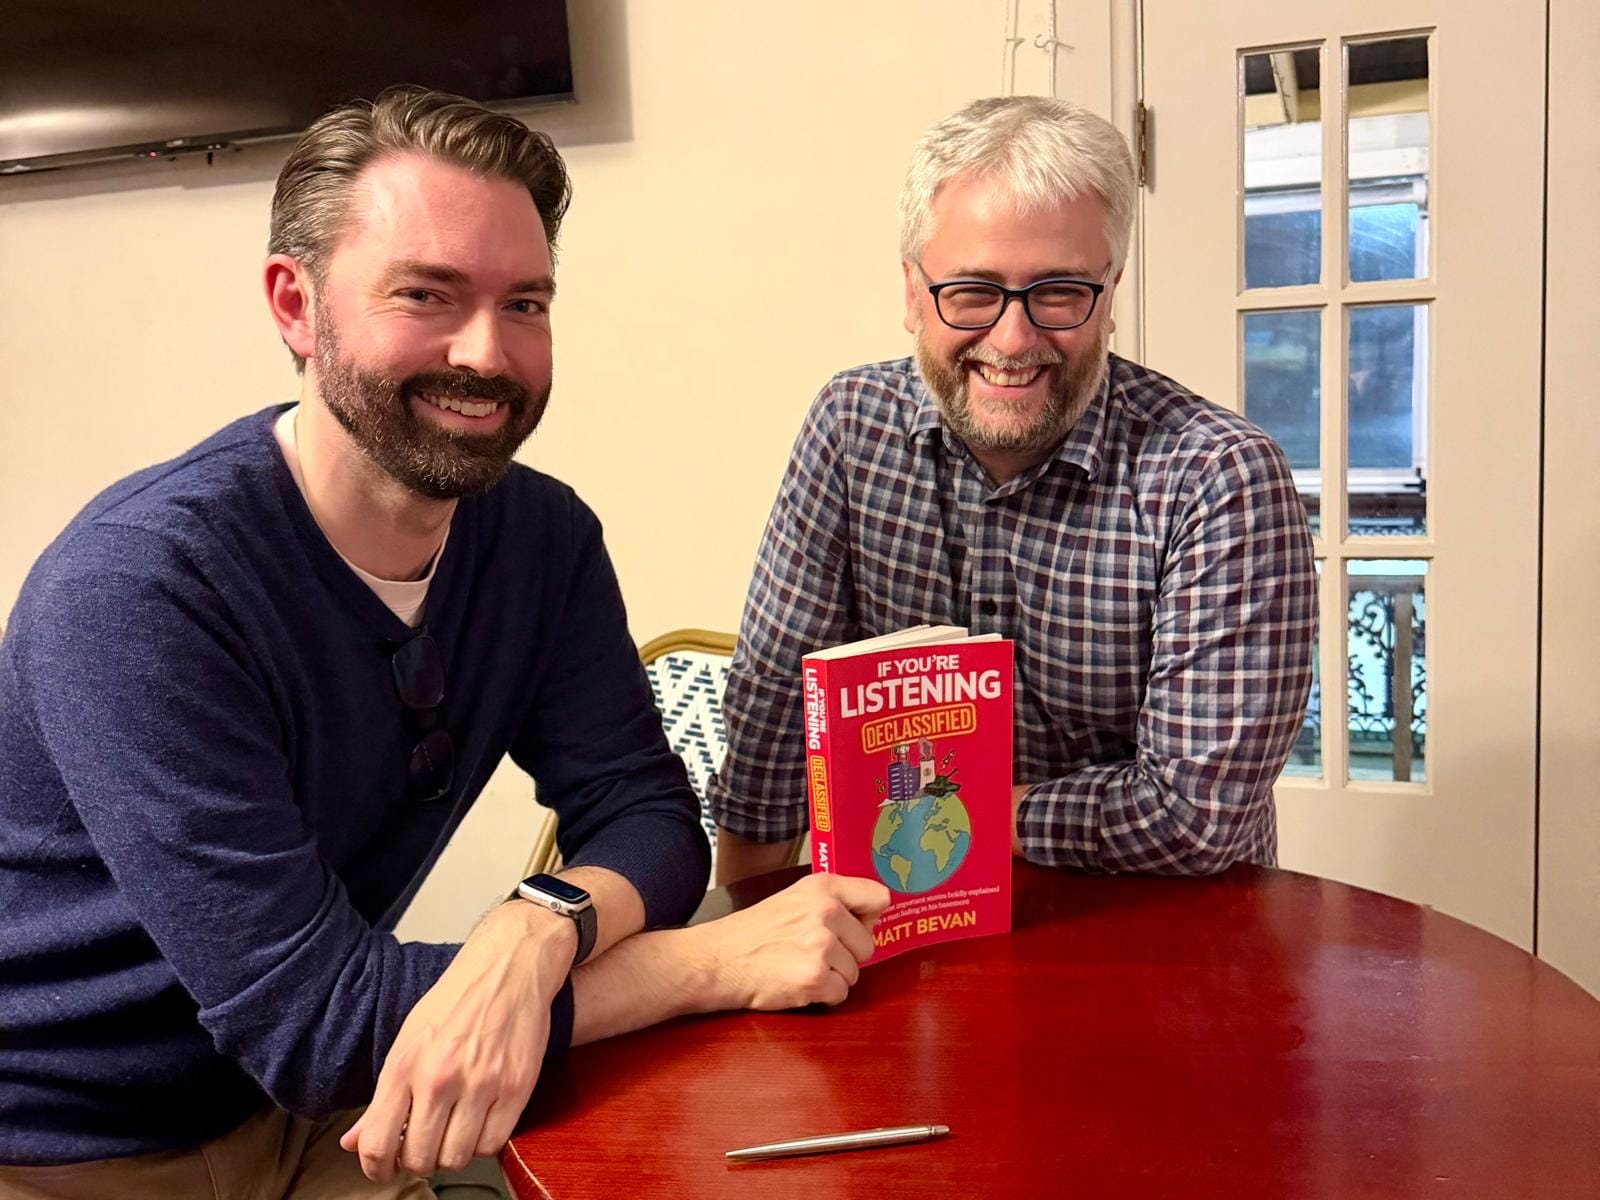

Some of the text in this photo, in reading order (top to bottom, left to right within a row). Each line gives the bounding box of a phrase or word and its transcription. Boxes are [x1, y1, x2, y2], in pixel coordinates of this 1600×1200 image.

[878, 654, 960, 678] IF YOU'RE
[805, 668, 821, 750] LISTENING
[840, 669, 1001, 719] LISTENING
[866, 708, 972, 749] DECLASSIFIED
[813, 758, 828, 830] DECLASSIFIED
[917, 910, 976, 935] BEVAN
